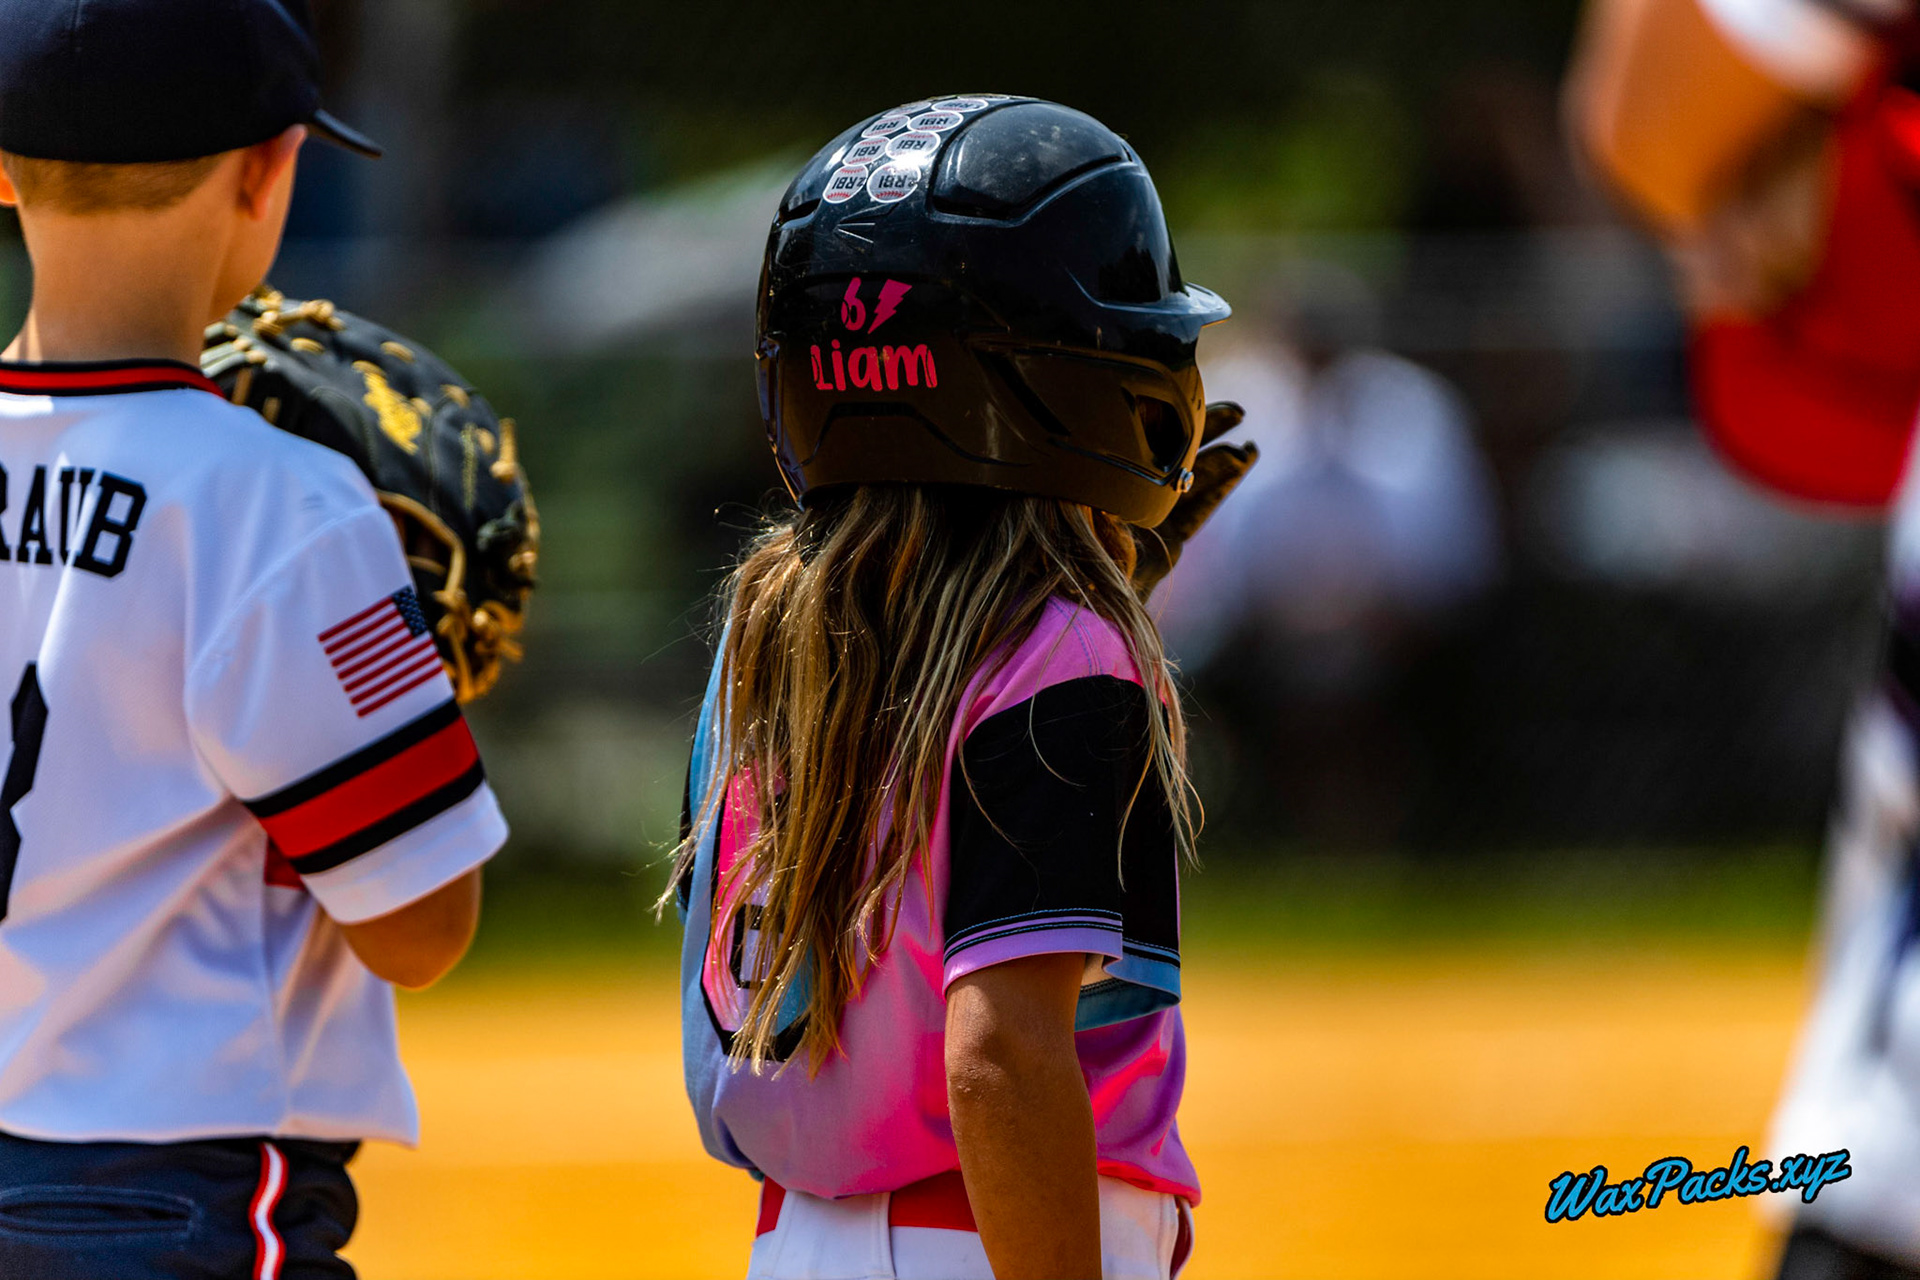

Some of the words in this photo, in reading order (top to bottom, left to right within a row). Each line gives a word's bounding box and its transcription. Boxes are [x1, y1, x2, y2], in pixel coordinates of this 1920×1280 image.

[872, 120, 900, 131] RBI
[919, 117, 949, 127] RBI
[898, 139, 927, 150] RBI
[853, 145, 881, 157] RBI
[841, 276, 866, 331] 6
[810, 338, 938, 391] Liam
